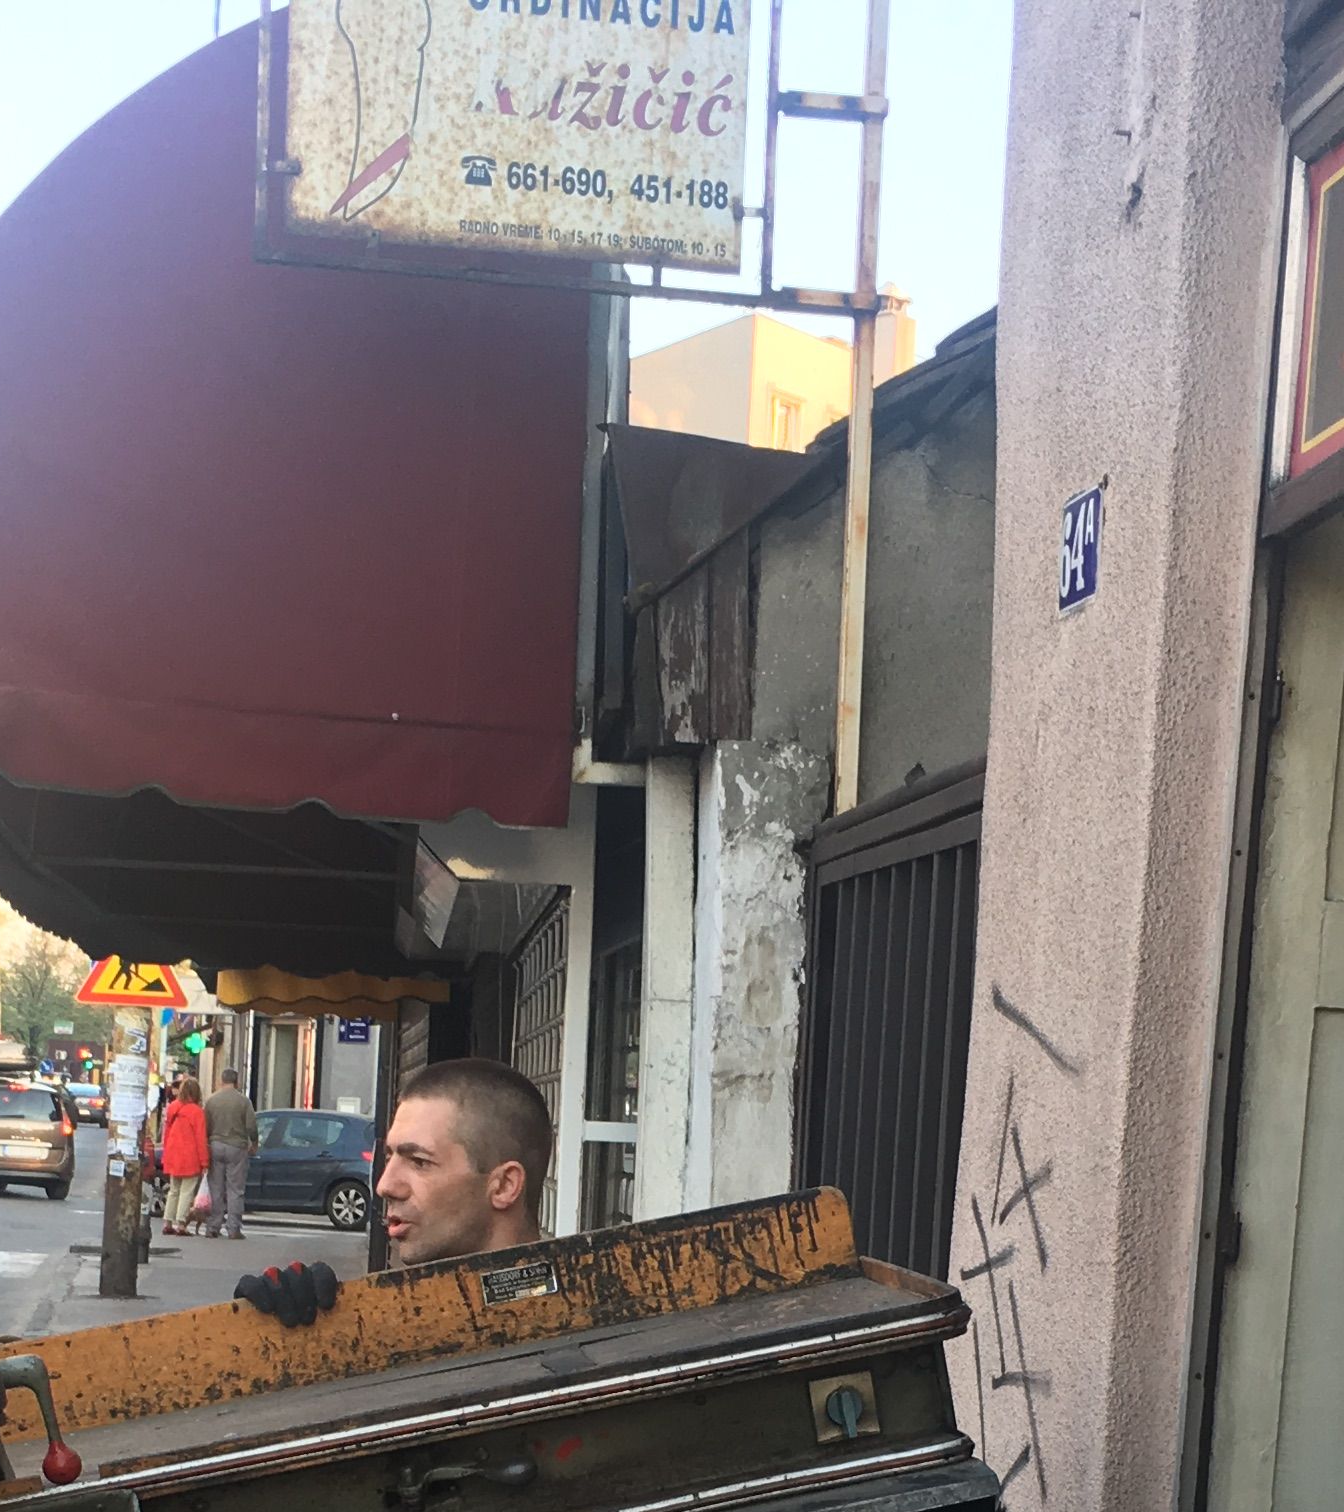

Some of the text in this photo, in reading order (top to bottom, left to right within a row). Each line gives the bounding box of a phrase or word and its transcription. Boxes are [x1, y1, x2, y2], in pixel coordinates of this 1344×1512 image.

[470, 0, 735, 35] NACIJA
[506, 161, 730, 210] 661-690, 451-188
[458, 219, 499, 237] RADNO
[502, 222, 544, 241] VREME:
